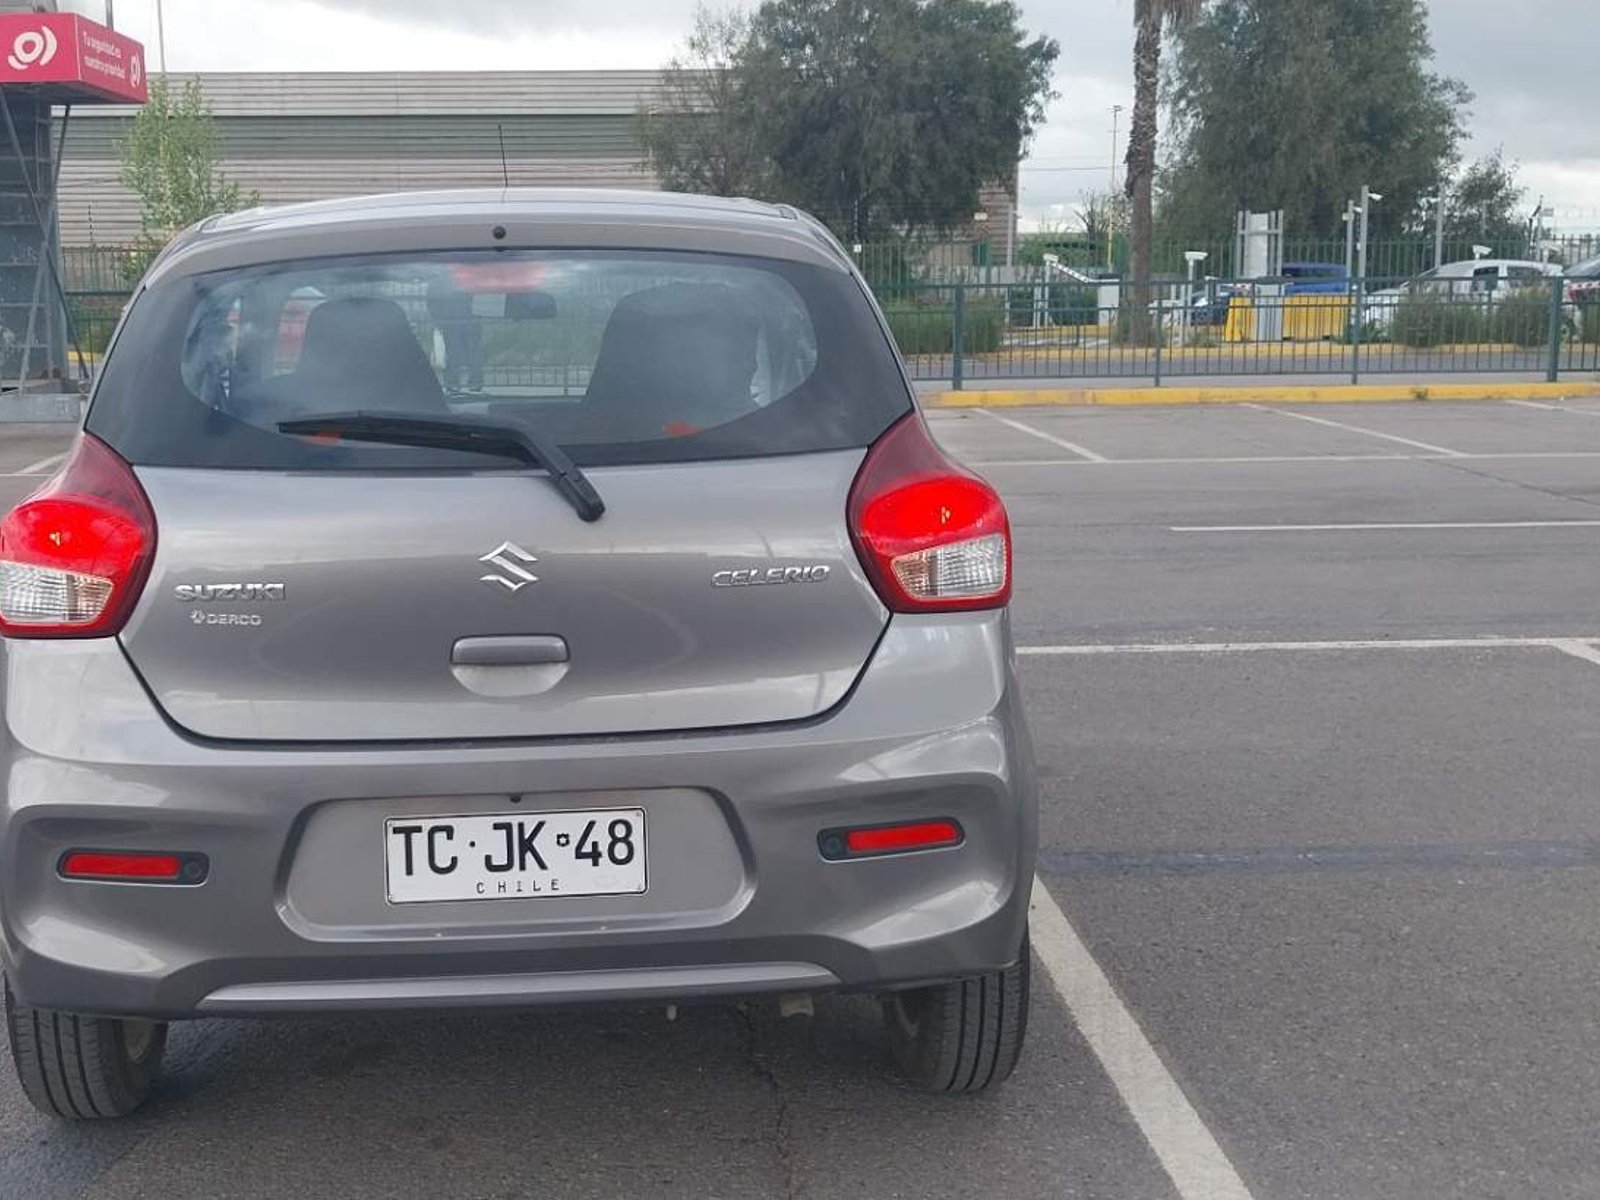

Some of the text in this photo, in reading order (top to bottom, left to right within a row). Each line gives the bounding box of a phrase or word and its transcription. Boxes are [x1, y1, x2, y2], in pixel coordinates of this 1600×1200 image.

[711, 565, 830, 587] CELERIO
[174, 583, 286, 600] SUZUKI
[206, 613, 262, 625] DERCO
[475, 878, 560, 895] CHILE
